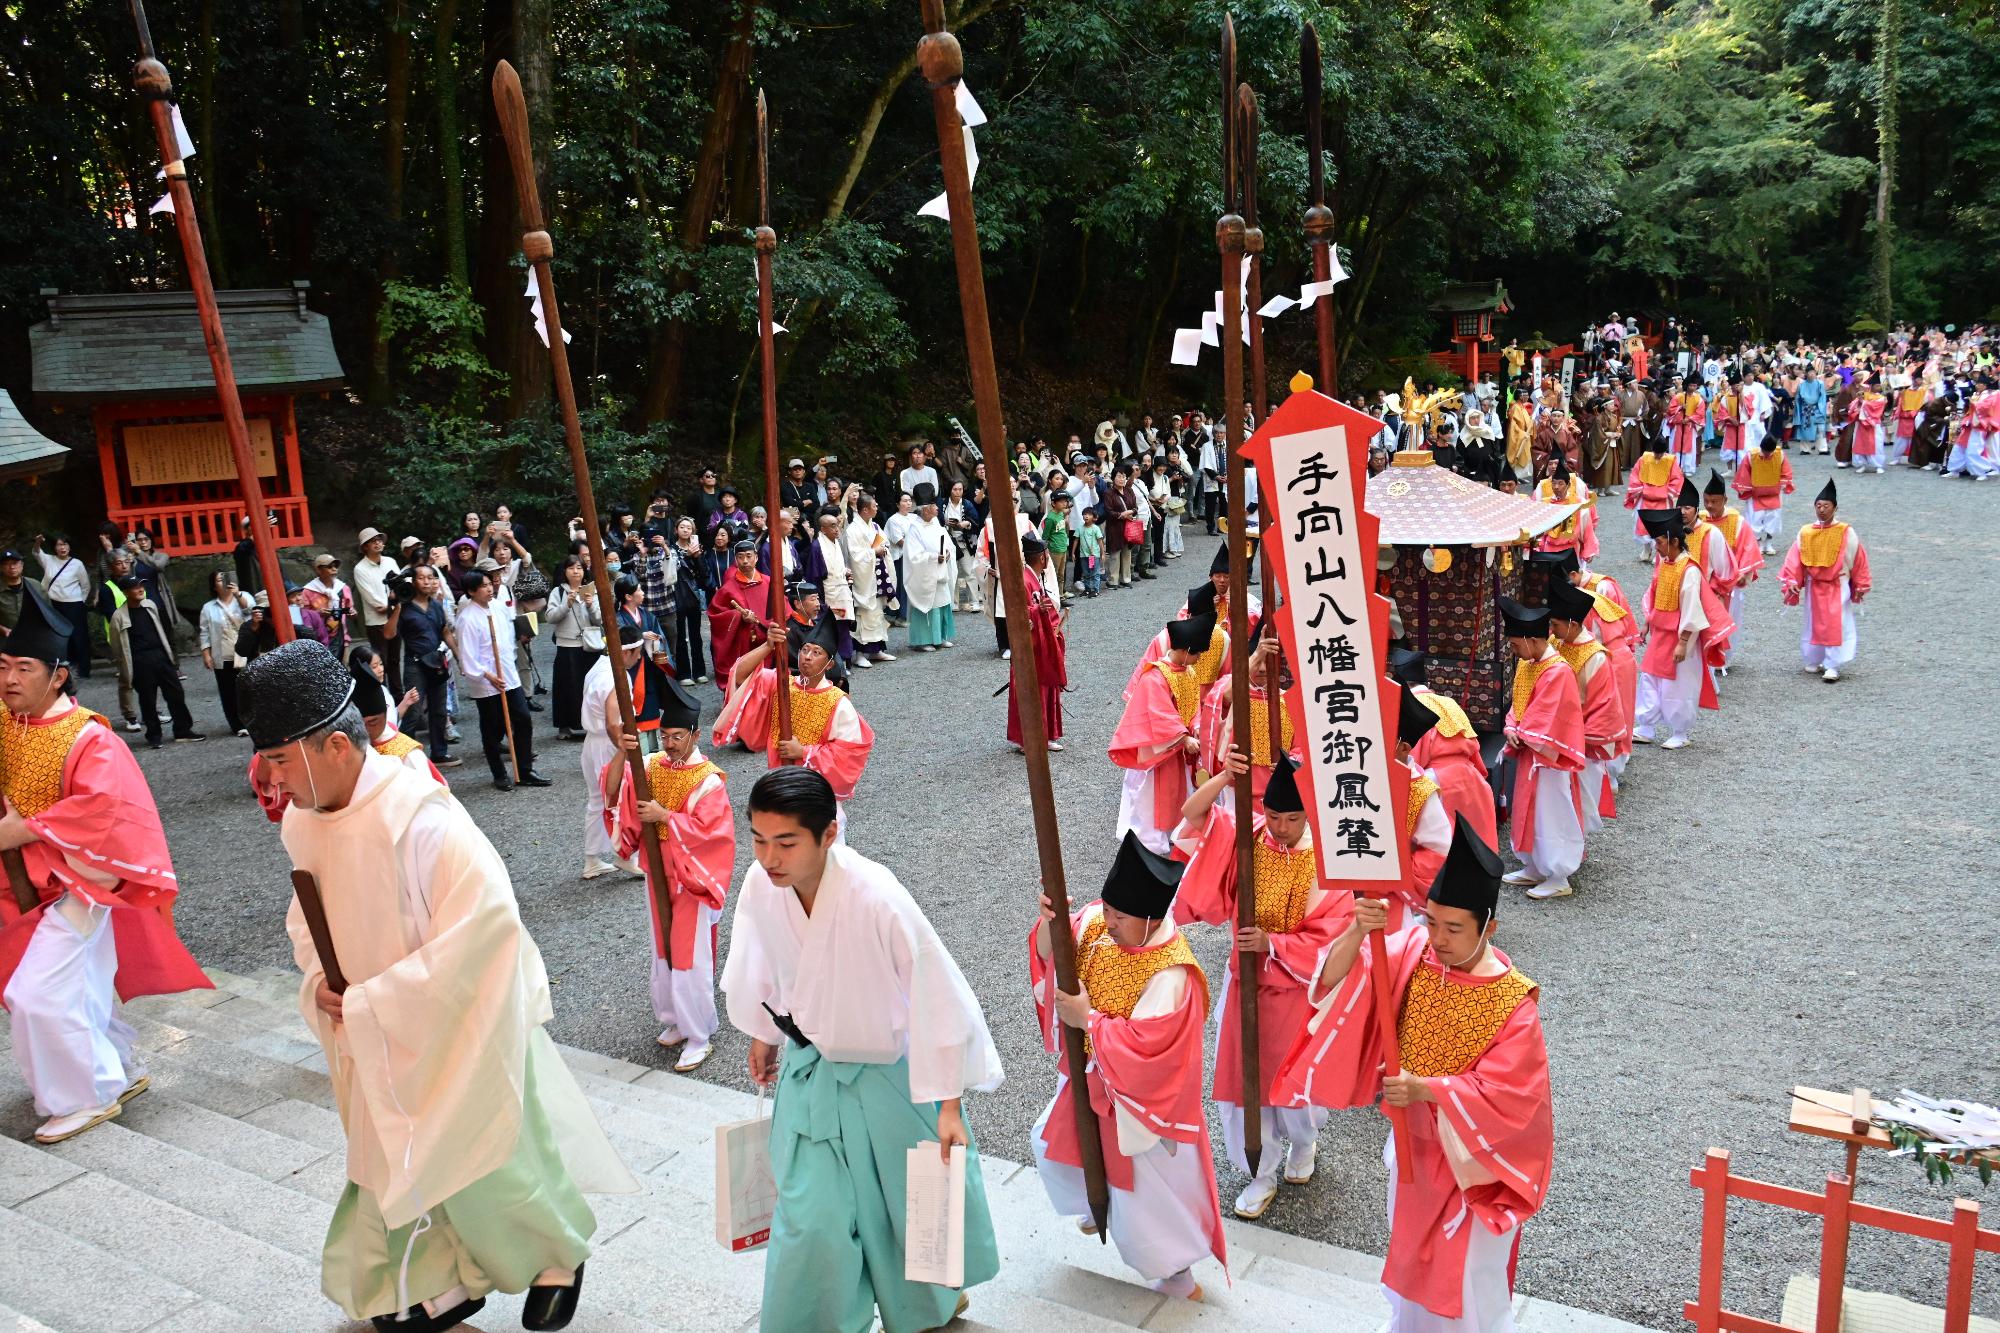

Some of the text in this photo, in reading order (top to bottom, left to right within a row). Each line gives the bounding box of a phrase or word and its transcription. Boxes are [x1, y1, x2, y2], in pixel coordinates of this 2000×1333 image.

[1287, 451, 1386, 859] 手向山八幡宮御鳳輦
